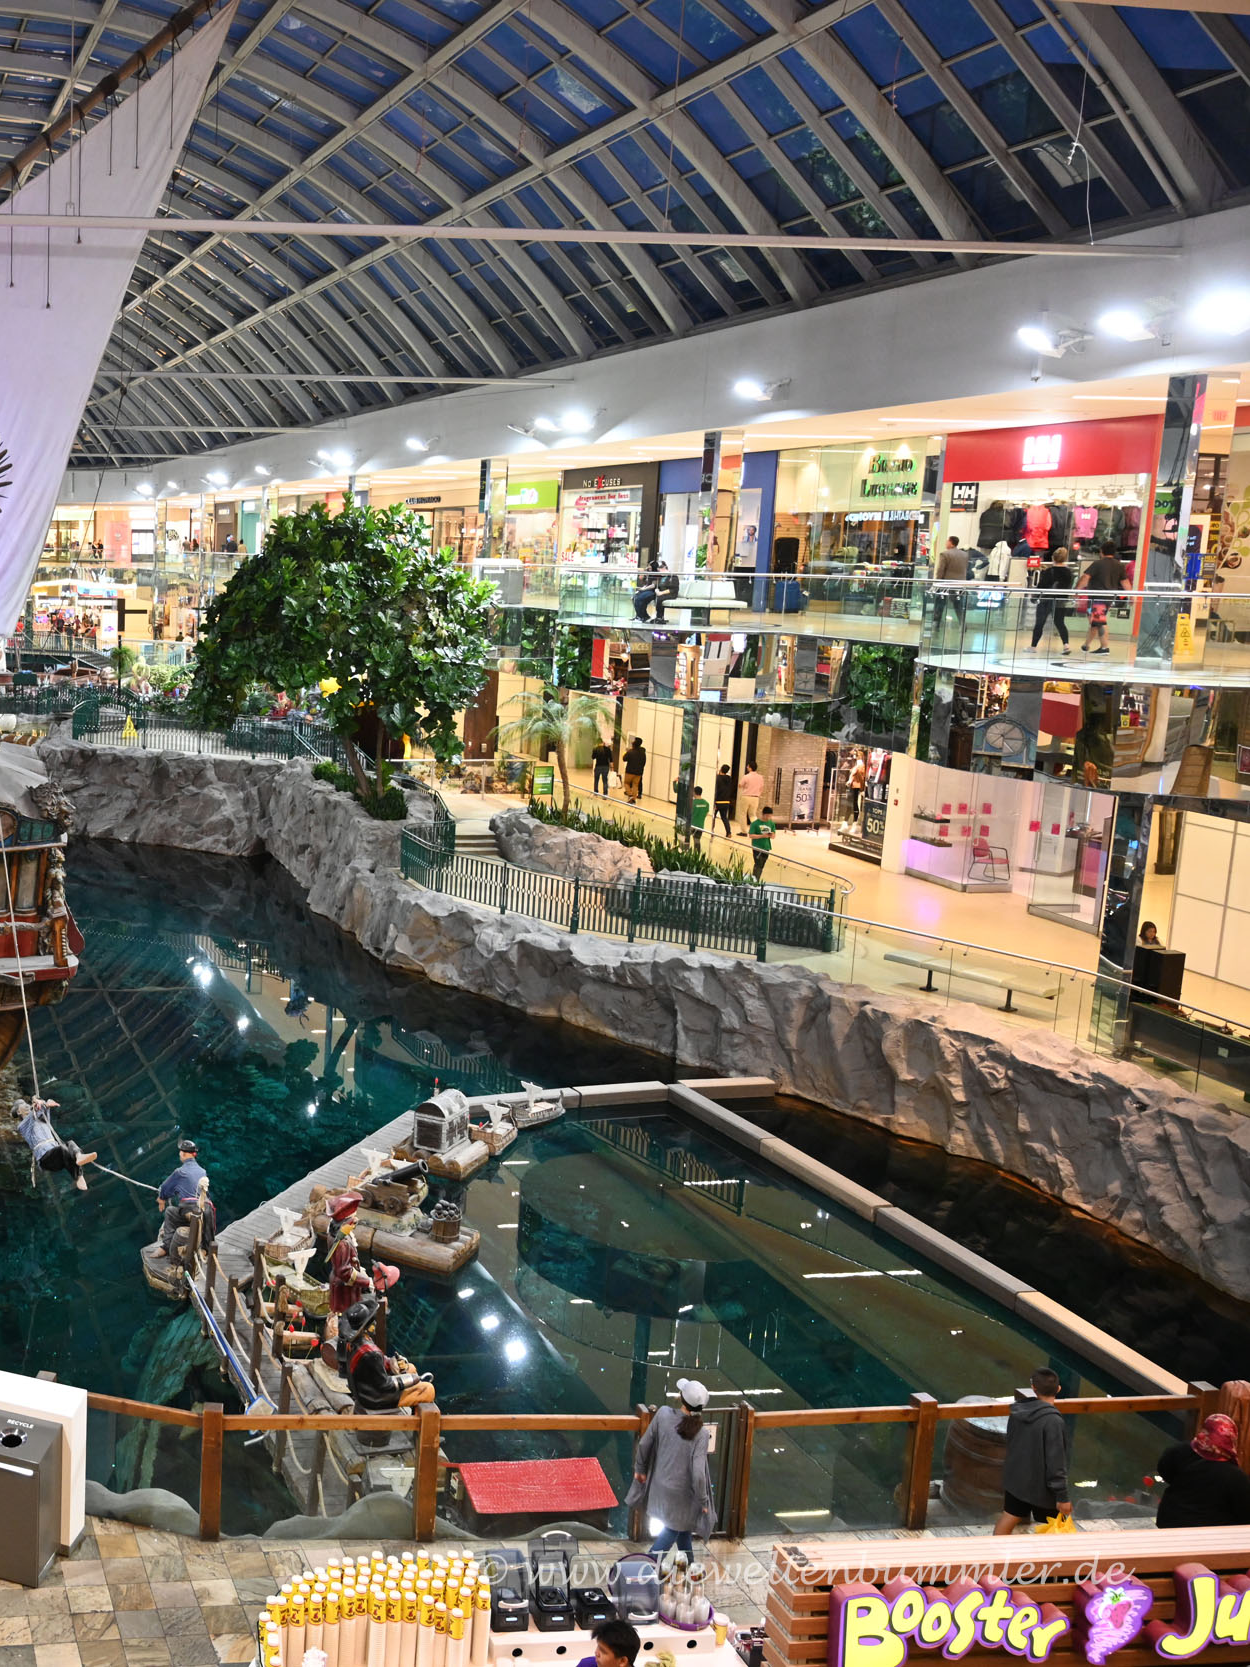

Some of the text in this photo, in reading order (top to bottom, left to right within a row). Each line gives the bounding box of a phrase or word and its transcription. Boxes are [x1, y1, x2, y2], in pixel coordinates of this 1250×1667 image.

[583, 475, 621, 490] NO EXCUSES
[953, 485, 977, 499] HH
[561, 552, 574, 562] SALE
[625, 553, 638, 564] SAL
[7, 1418, 35, 1429] RECYCLE
[842, 1588, 1068, 1667] Booster
